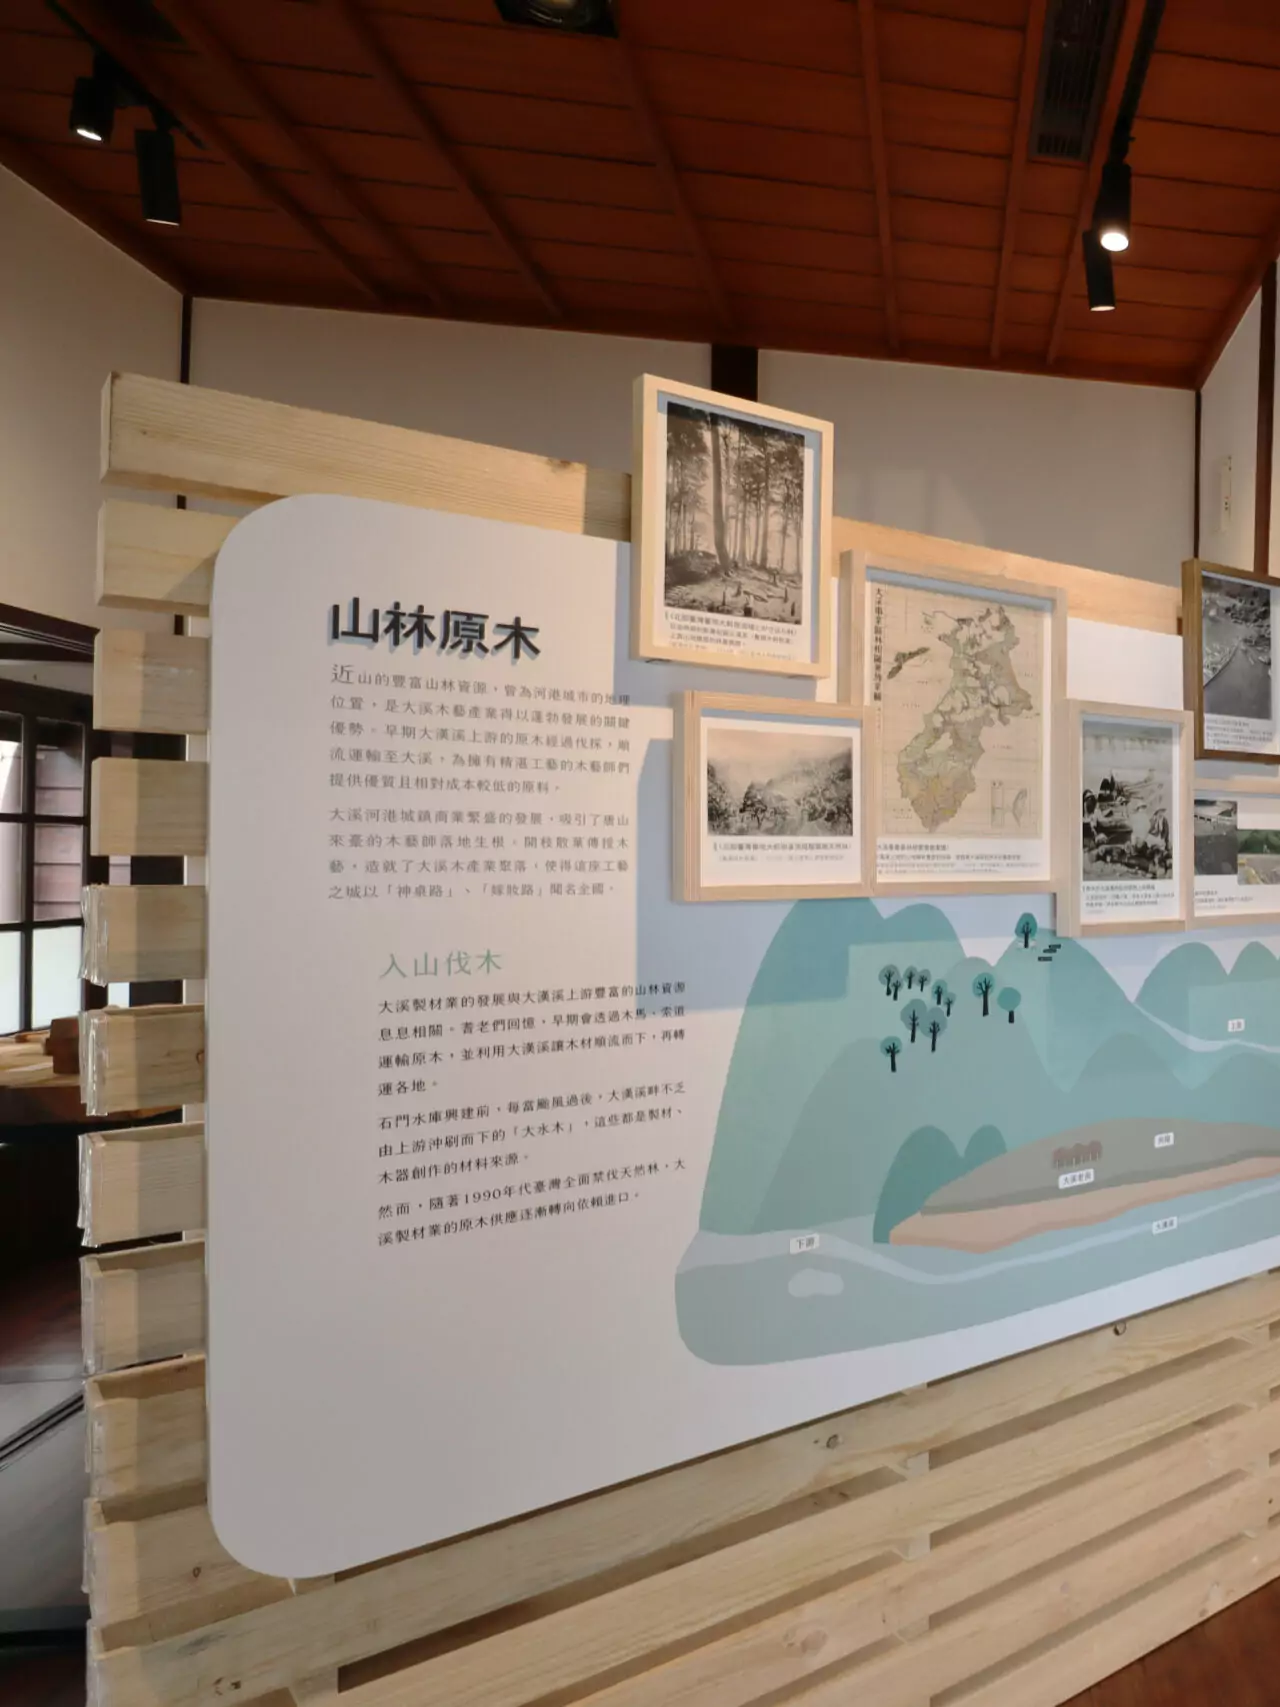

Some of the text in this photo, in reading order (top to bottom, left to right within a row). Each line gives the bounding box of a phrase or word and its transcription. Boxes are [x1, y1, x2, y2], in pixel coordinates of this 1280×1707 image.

[330, 596, 542, 659] 山林原木
[378, 948, 503, 979] 入山伐木
[378, 1078, 439, 1097] 運各地。
[378, 1151, 530, 1184] 木器創作的材料來源。
